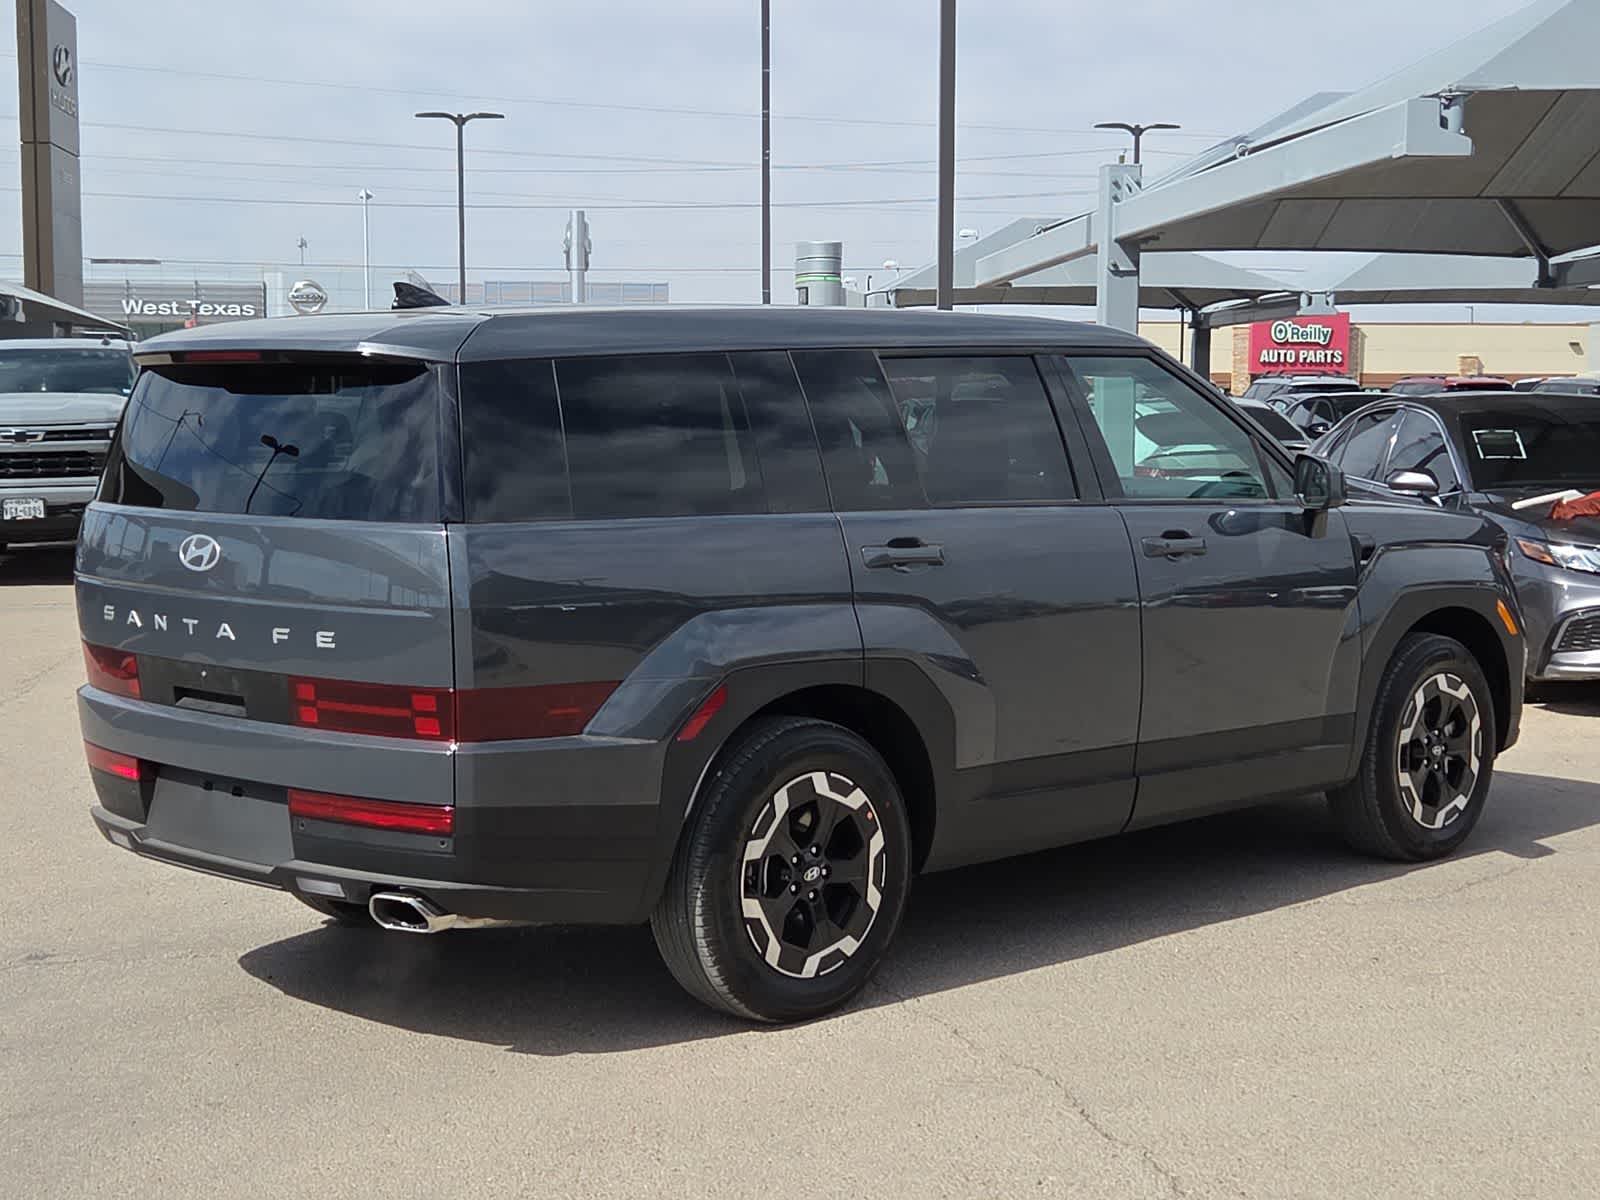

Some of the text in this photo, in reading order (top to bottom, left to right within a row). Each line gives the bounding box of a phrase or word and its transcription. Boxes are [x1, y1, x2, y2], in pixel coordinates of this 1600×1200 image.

[122, 299, 256, 316] West Texas
[1271, 320, 1331, 345] O'Reilly
[1260, 349, 1343, 363] AUTO PARTS
[103, 604, 336, 649] SANTA FE
